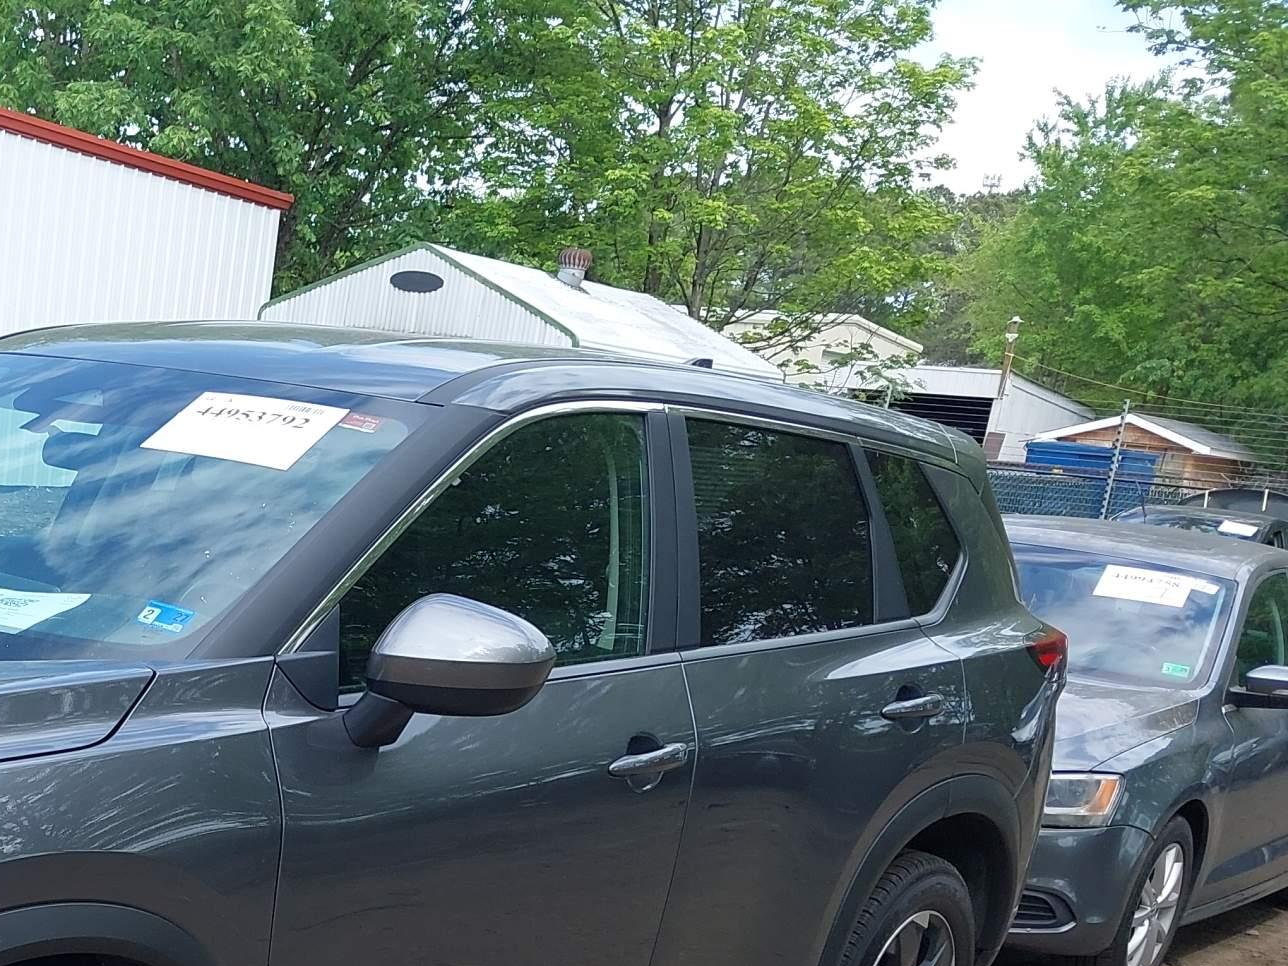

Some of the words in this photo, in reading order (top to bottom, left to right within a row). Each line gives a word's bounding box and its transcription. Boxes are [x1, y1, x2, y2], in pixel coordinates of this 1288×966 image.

[196, 405, 311, 430] 44953792
[143, 608, 155, 620] 2
[172, 611, 190, 623] 27
